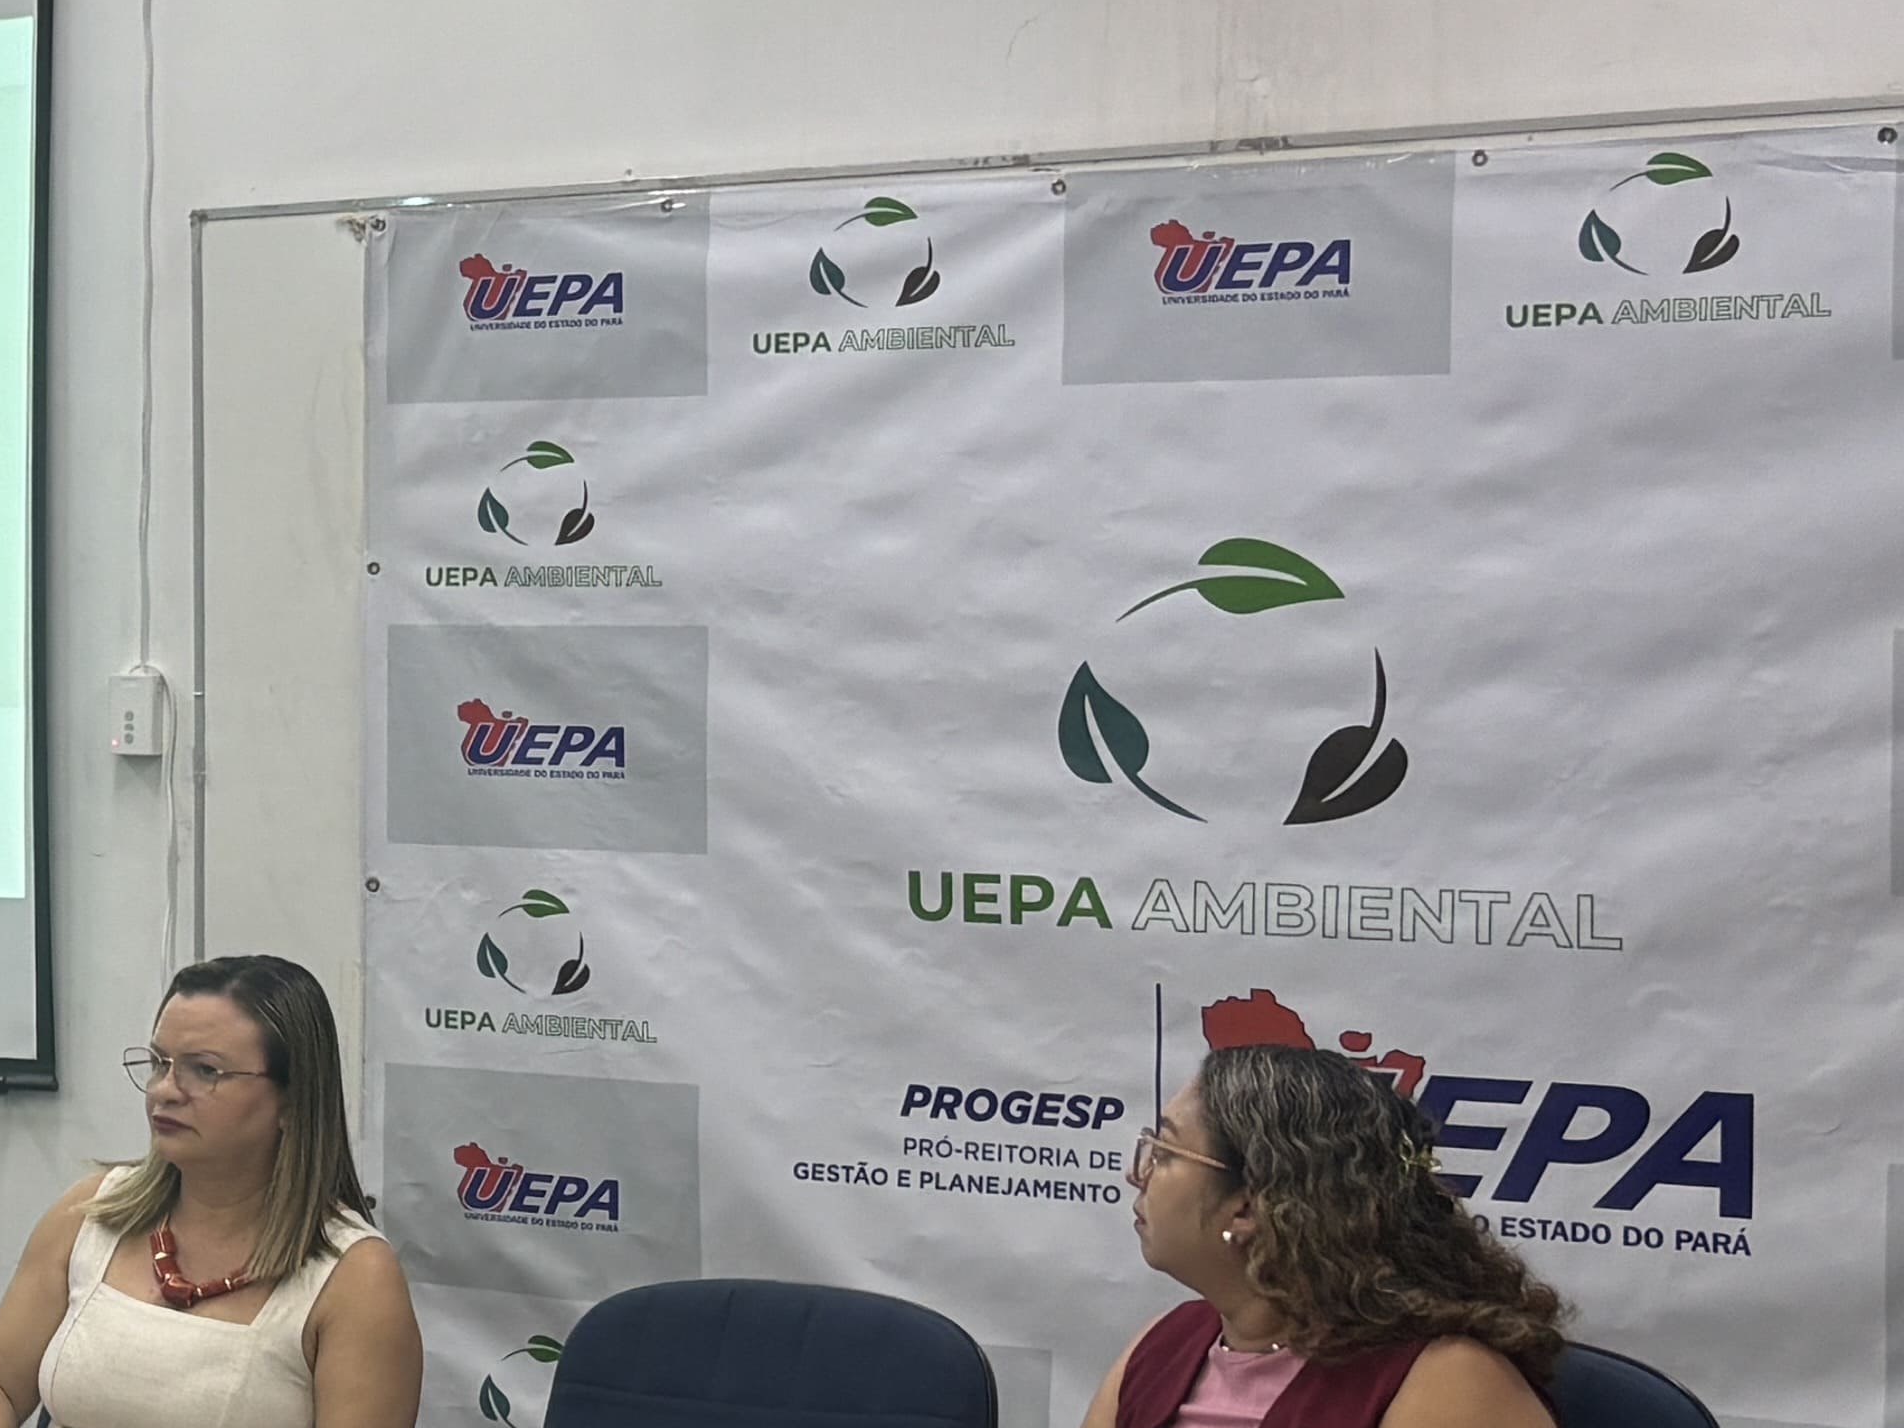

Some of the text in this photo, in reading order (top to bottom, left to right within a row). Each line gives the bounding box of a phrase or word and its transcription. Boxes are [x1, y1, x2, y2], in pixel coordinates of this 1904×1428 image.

[1162, 240, 1352, 294] UEPA
[466, 270, 624, 322] UEPA
[1506, 291, 1833, 329] UEPA AMBIENTAL
[753, 323, 1016, 355] UEPA AMBIENTAL
[425, 564, 663, 588] UEPA AMBIENTAL
[465, 723, 625, 770] UEPA
[908, 870, 1624, 952] UEPA AMBIENTAL
[425, 1007, 658, 1044] UEPA AMBIENTAL
[900, 1083, 1125, 1130] PROGESP
[903, 1135, 1122, 1172] PRÓ-REITORIA DE
[1373, 1071, 1755, 1220] EPA
[461, 1170, 620, 1223] UEPA
[793, 1161, 1121, 1204] GESTÃO E PLANEJAMENTO
[1500, 1216, 1752, 1257] ESTADO DO PARÁ
